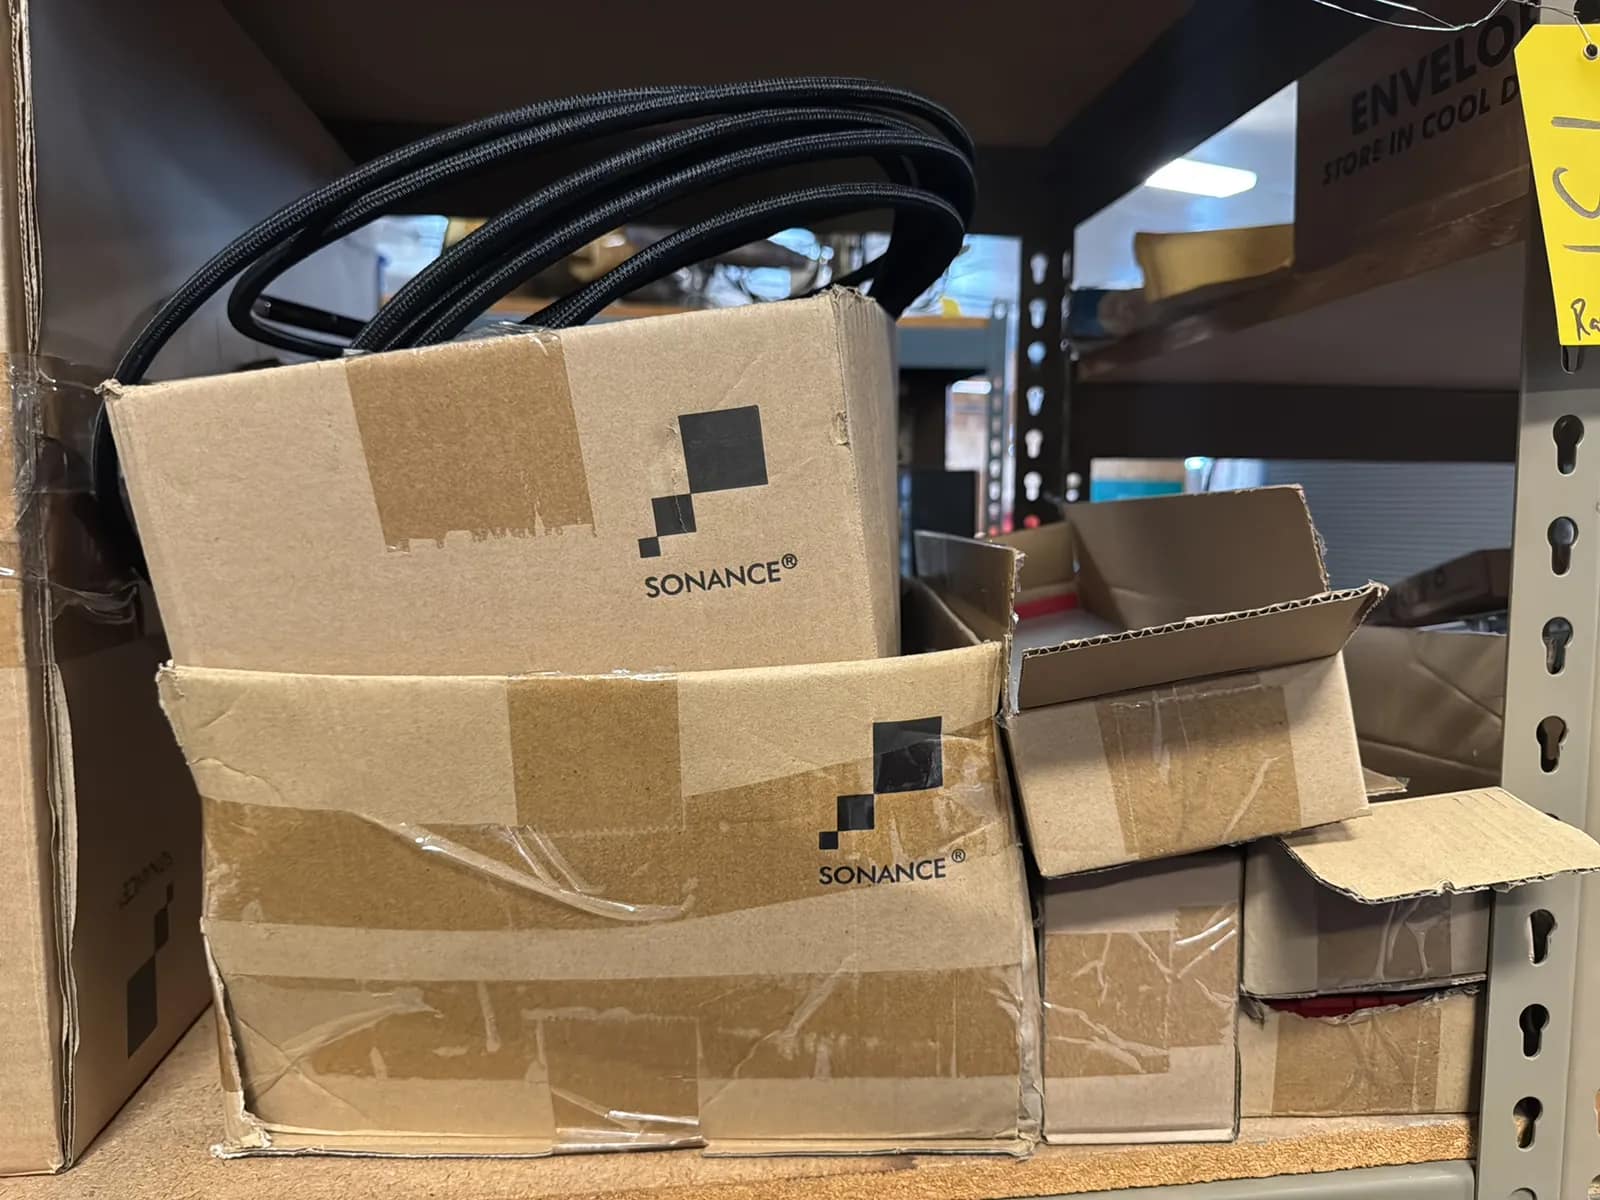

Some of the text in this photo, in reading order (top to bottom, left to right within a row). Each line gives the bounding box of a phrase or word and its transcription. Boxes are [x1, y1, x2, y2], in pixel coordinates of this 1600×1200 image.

[1322, 138, 1382, 186] STORE
[1390, 124, 1414, 156] IN
[1422, 88, 1490, 139] COOL
